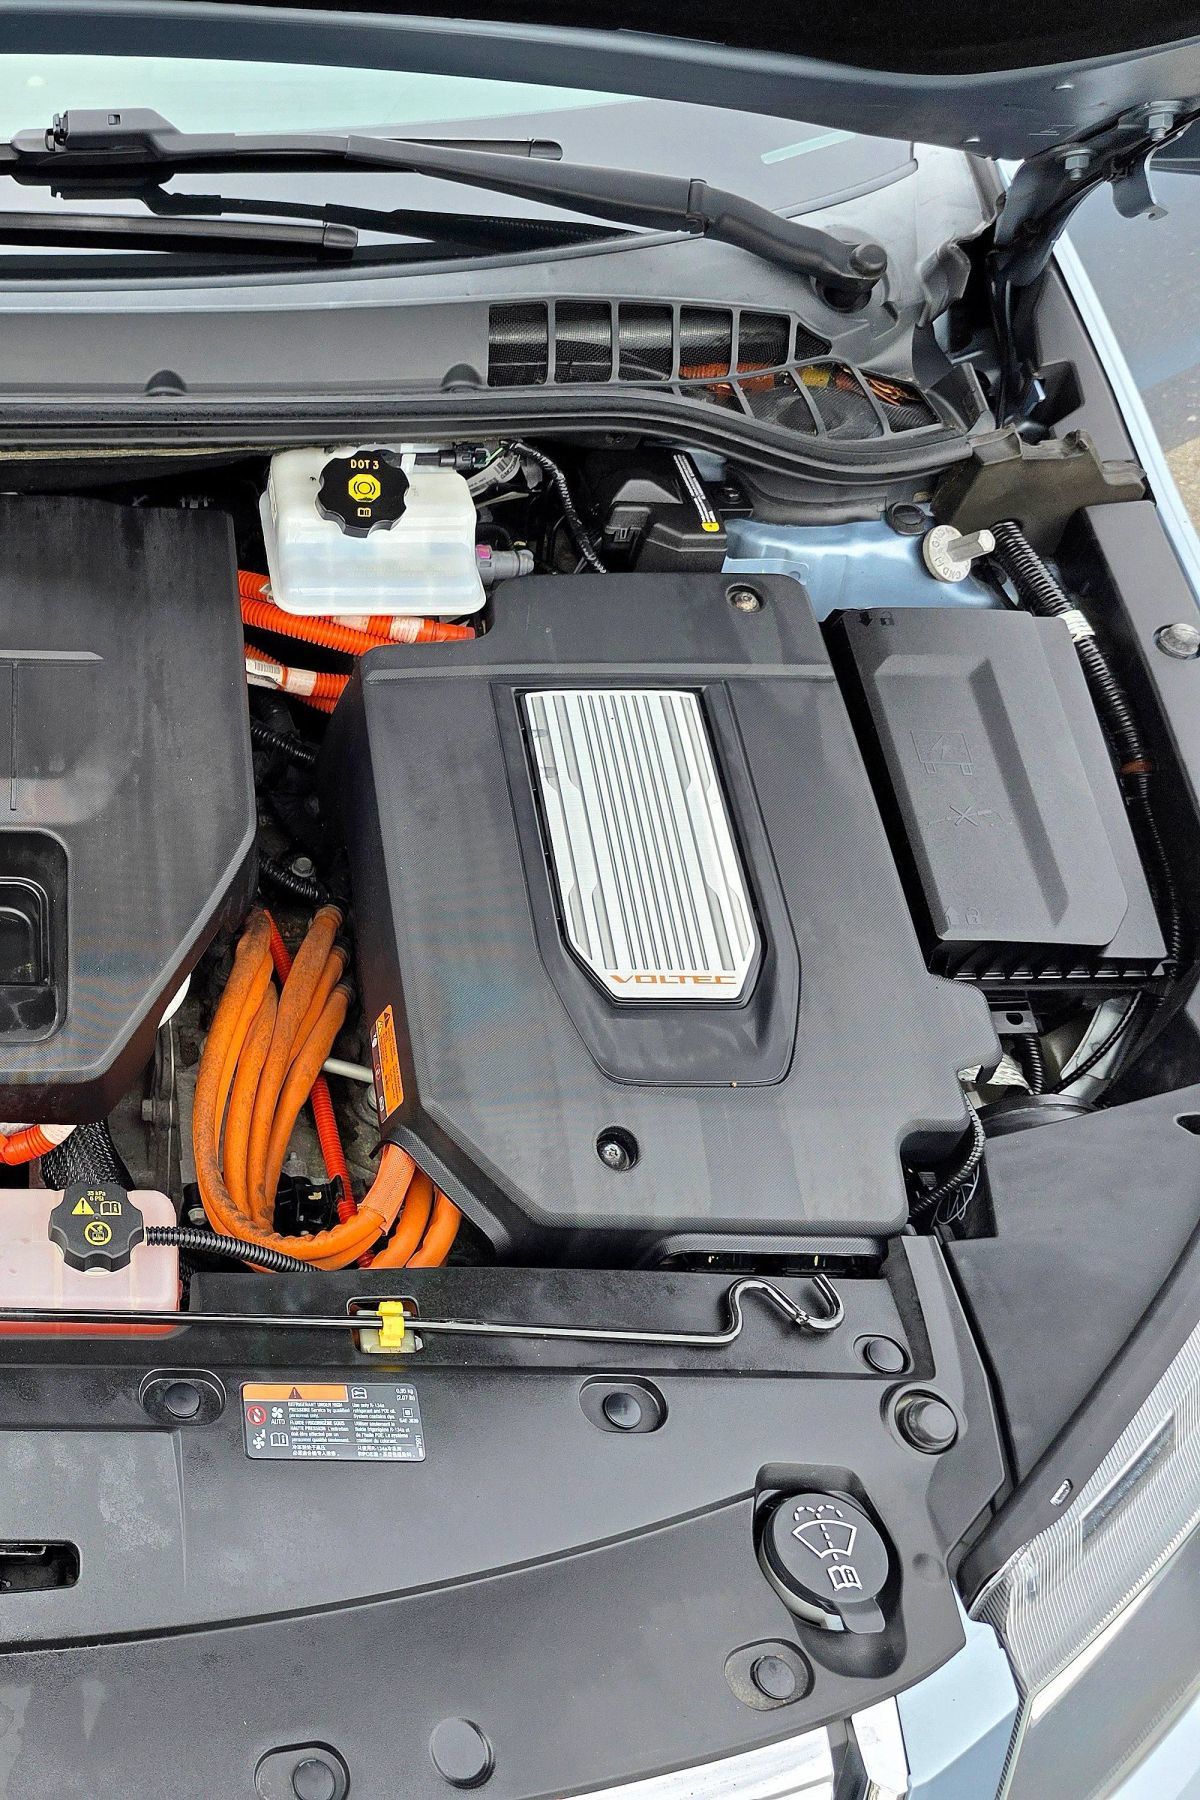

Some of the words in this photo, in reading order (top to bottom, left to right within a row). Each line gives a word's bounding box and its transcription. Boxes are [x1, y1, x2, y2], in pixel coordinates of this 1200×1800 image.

[350, 459, 370, 468] DOT
[373, 461, 380, 470] 3
[610, 975, 736, 984] VOLTEC
